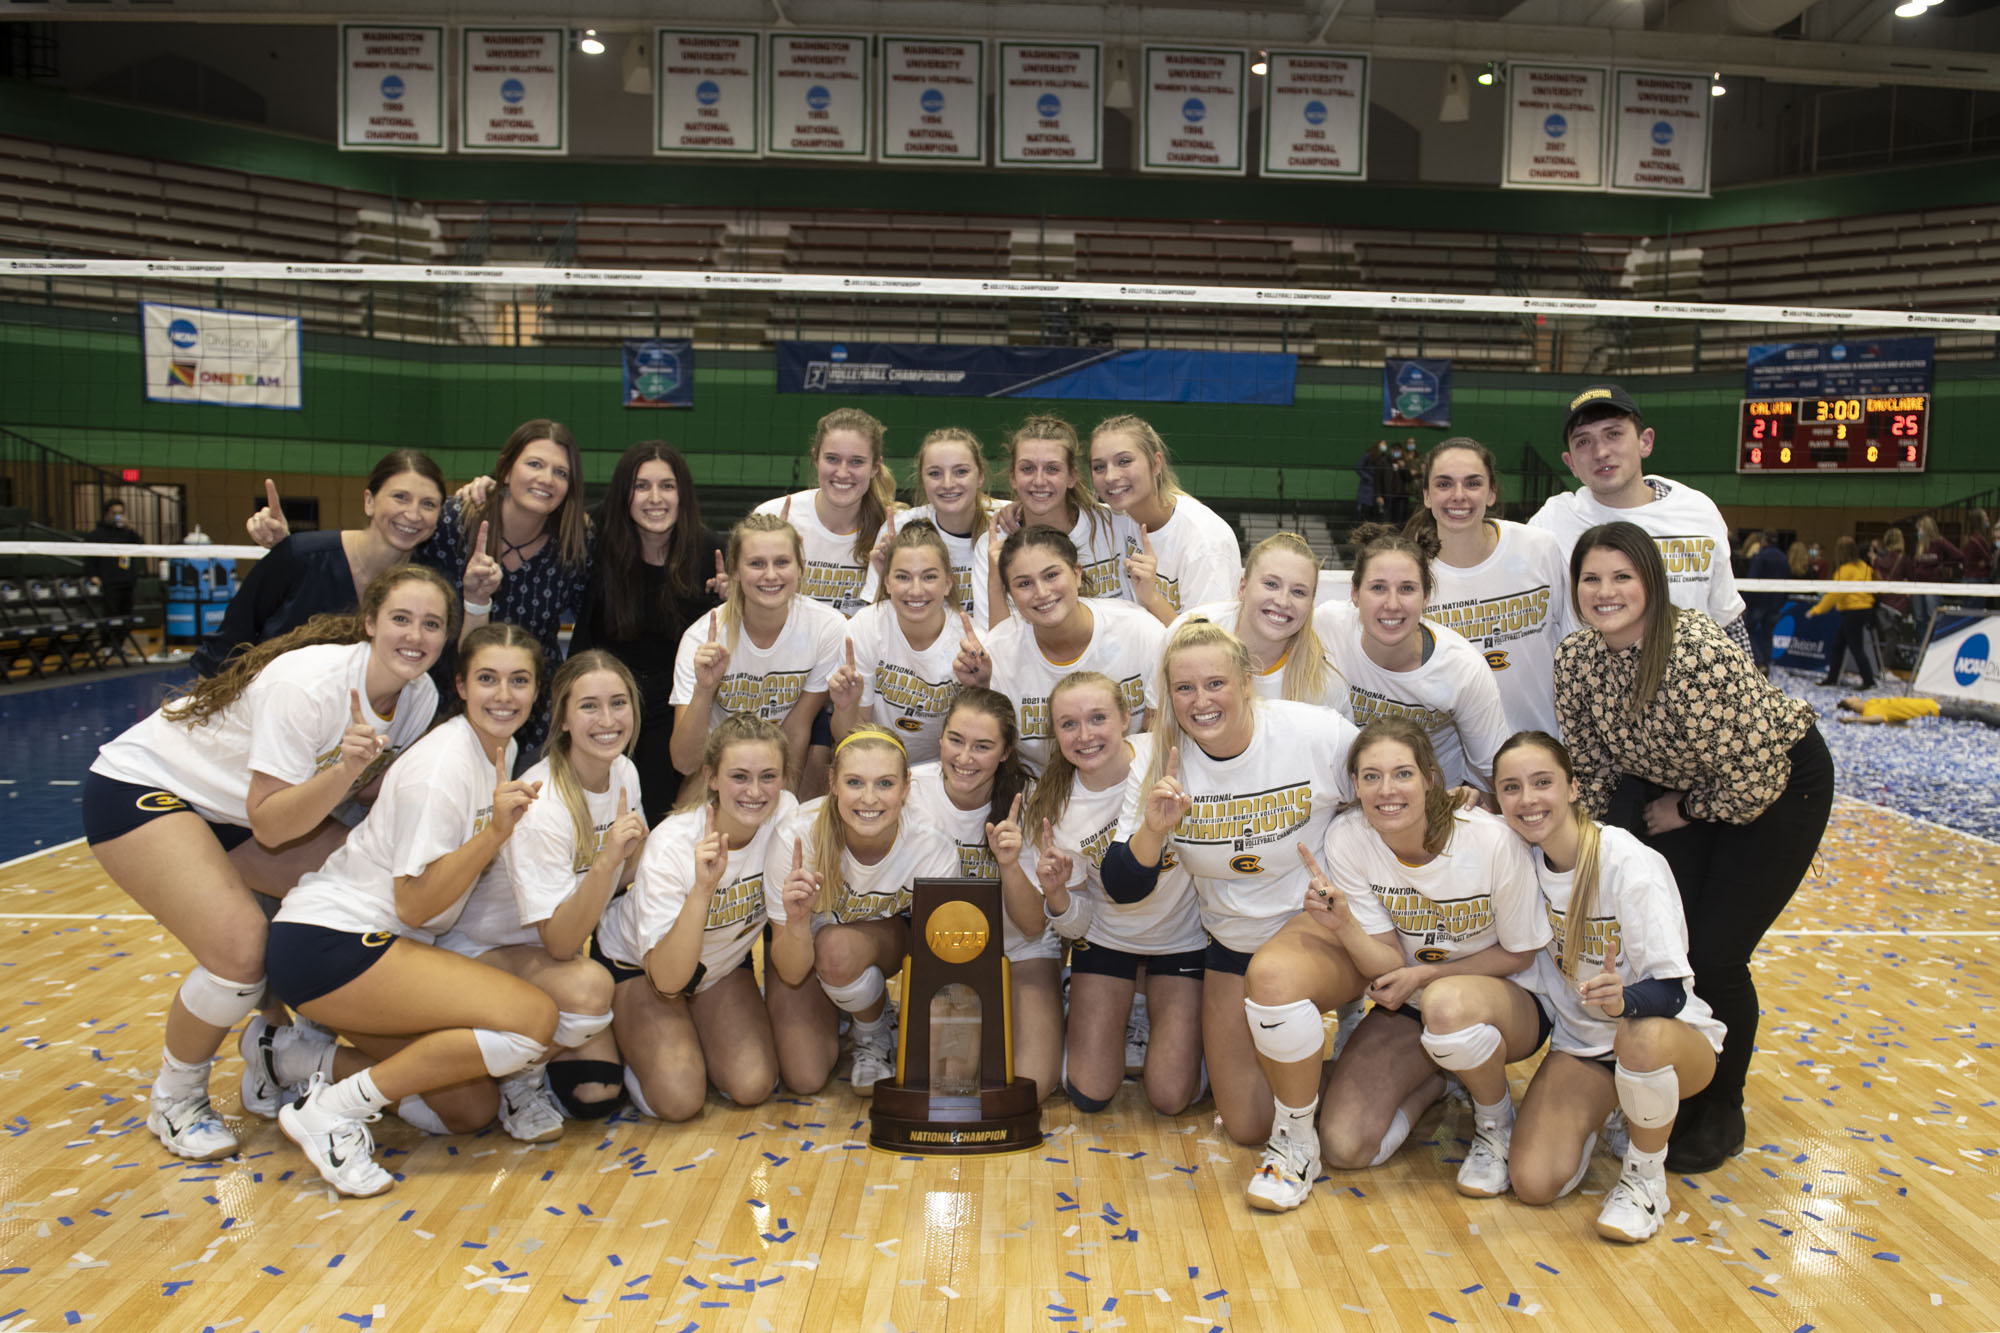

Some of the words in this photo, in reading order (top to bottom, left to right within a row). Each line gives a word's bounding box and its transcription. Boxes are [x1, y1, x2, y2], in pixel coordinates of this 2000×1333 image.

[362, 32, 424, 42] WASHINGTON
[484, 36, 544, 44] WASHINGTON
[678, 38, 740, 48] WASHINGTON
[790, 42, 850, 50] WASHINGTON
[366, 46, 420, 56] UNIVERSITY
[486, 50, 540, 58] UNIVERSITY
[904, 46, 964, 56] WASHINGTON
[1020, 50, 1080, 60] WASHINGTON
[682, 52, 736, 62] UNIVERSITY
[792, 56, 846, 64] UNIVERSITY
[1166, 52, 1226, 66] WASHINGTON
[906, 60, 960, 70] UNIVERSITY
[1288, 56, 1350, 70] WASHINGTON
[1022, 64, 1076, 74] UNIVERSITY
[1168, 70, 1222, 80] UNIVERSITY
[1292, 74, 1344, 82] UNIVERSITY
[1530, 72, 1588, 84] WASHINGTON
[1636, 76, 1696, 90] WASHINGTON
[1532, 86, 1582, 96] UNIVERSITY
[1638, 92, 1690, 104] UNIVERSITY
[370, 116, 414, 128] NATIONAL
[490, 120, 534, 128] NATIONAL
[684, 122, 728, 132] NATIONAL
[366, 130, 418, 140] CHAMPIONS
[796, 126, 840, 136] NATIONAL
[908, 130, 954, 140] NATIONAL
[486, 134, 538, 142] CHAMPIONS
[680, 136, 734, 146] CHAMPIONS
[792, 138, 844, 148] CHAMPIONS
[1026, 134, 1070, 142] NATIONAL
[904, 142, 958, 152] CHAMPIONS
[1170, 140, 1214, 150] NATIONAL
[1292, 144, 1336, 154] NATIONAL
[1022, 148, 1076, 156] CHAMPIONS
[1166, 152, 1220, 164] CHAMPIONS
[1288, 156, 1340, 166] CHAMPIONS
[1534, 156, 1576, 166] NATIONAL
[1640, 160, 1680, 172] NATIONAL
[1530, 168, 1580, 178] CHAMPIONS
[1636, 174, 1684, 184] CHAMPIONS
[200, 371, 280, 388] ONETEAM
[829, 368, 886, 381] VOLLEYBALL
[888, 369, 966, 382] CHAMPIONSHIP
[1750, 402, 1792, 416] CALVIN
[1816, 400, 1860, 420] 3:00
[1752, 418, 1778, 439] 21
[1892, 414, 1918, 436] 25
[1836, 424, 1846, 440] 3
[1780, 448, 1792, 464] 0
[1867, 446, 1878, 462] 0
[1906, 446, 1917, 462] 3
[1442, 598, 1479, 610] NATIONAL
[1507, 608, 1538, 618] VOLLEYBALL
[885, 664, 916, 677] NATIONAL
[1956, 657, 1987, 674] NCAA
[1350, 685, 1386, 701] NATIONAL
[1194, 793, 1232, 804] NATIONAL
[1233, 812, 1258, 822] WOMEN'S
[1260, 805, 1294, 816] VOLLEYBALL
[1245, 836, 1276, 847] VOLLEYBALL
[1276, 816, 1312, 840] CHAMPIONSHIP
[1080, 833, 1098, 848] 2021
[1452, 912, 1487, 922] VOLLEYBALL
[932, 931, 986, 950] NCAA
[910, 1130, 954, 1143] NATIONAL
[956, 1130, 1008, 1143] CHAMPION
